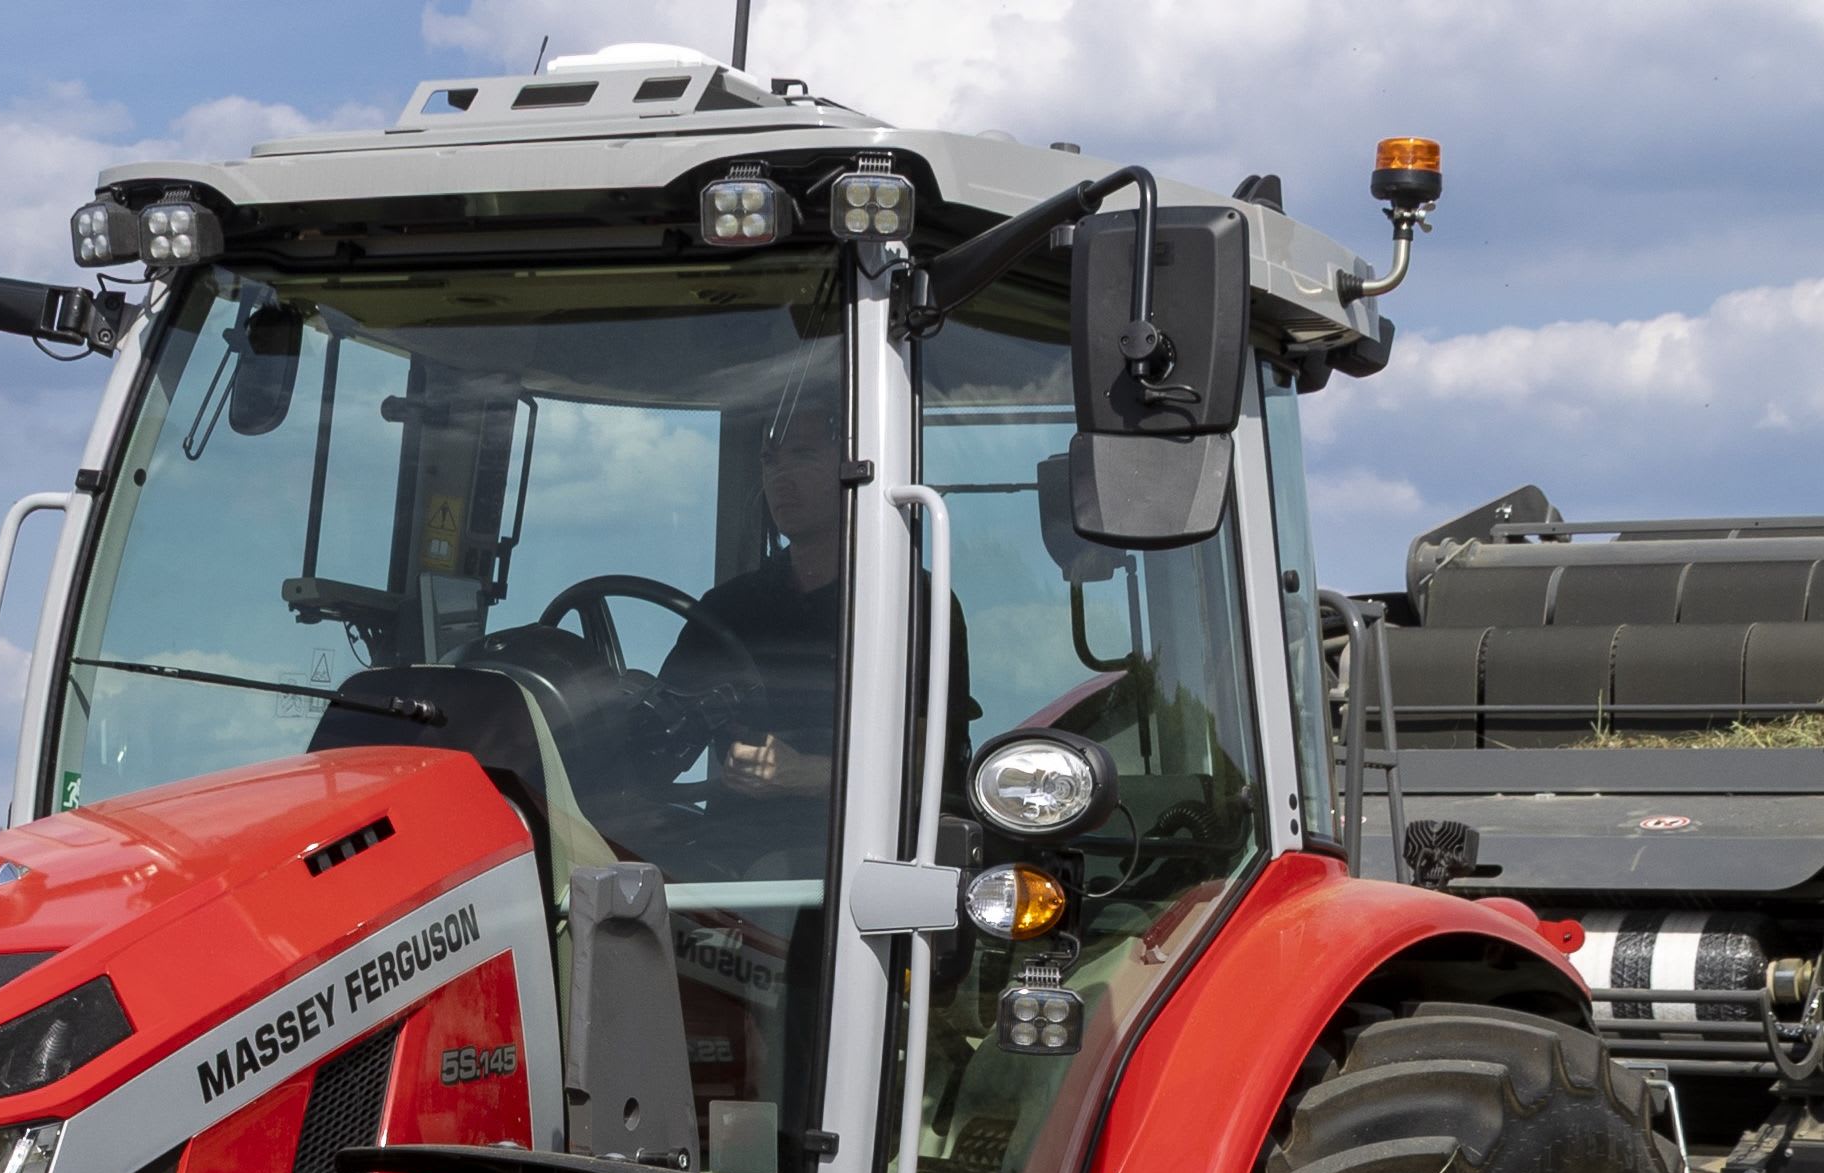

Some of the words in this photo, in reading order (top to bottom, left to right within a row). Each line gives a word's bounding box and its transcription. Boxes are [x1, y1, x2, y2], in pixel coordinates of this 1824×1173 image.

[197, 984, 335, 1104] MASSEY
[344, 904, 480, 1013] FERGUSON
[440, 1044, 517, 1086] 5S.145
